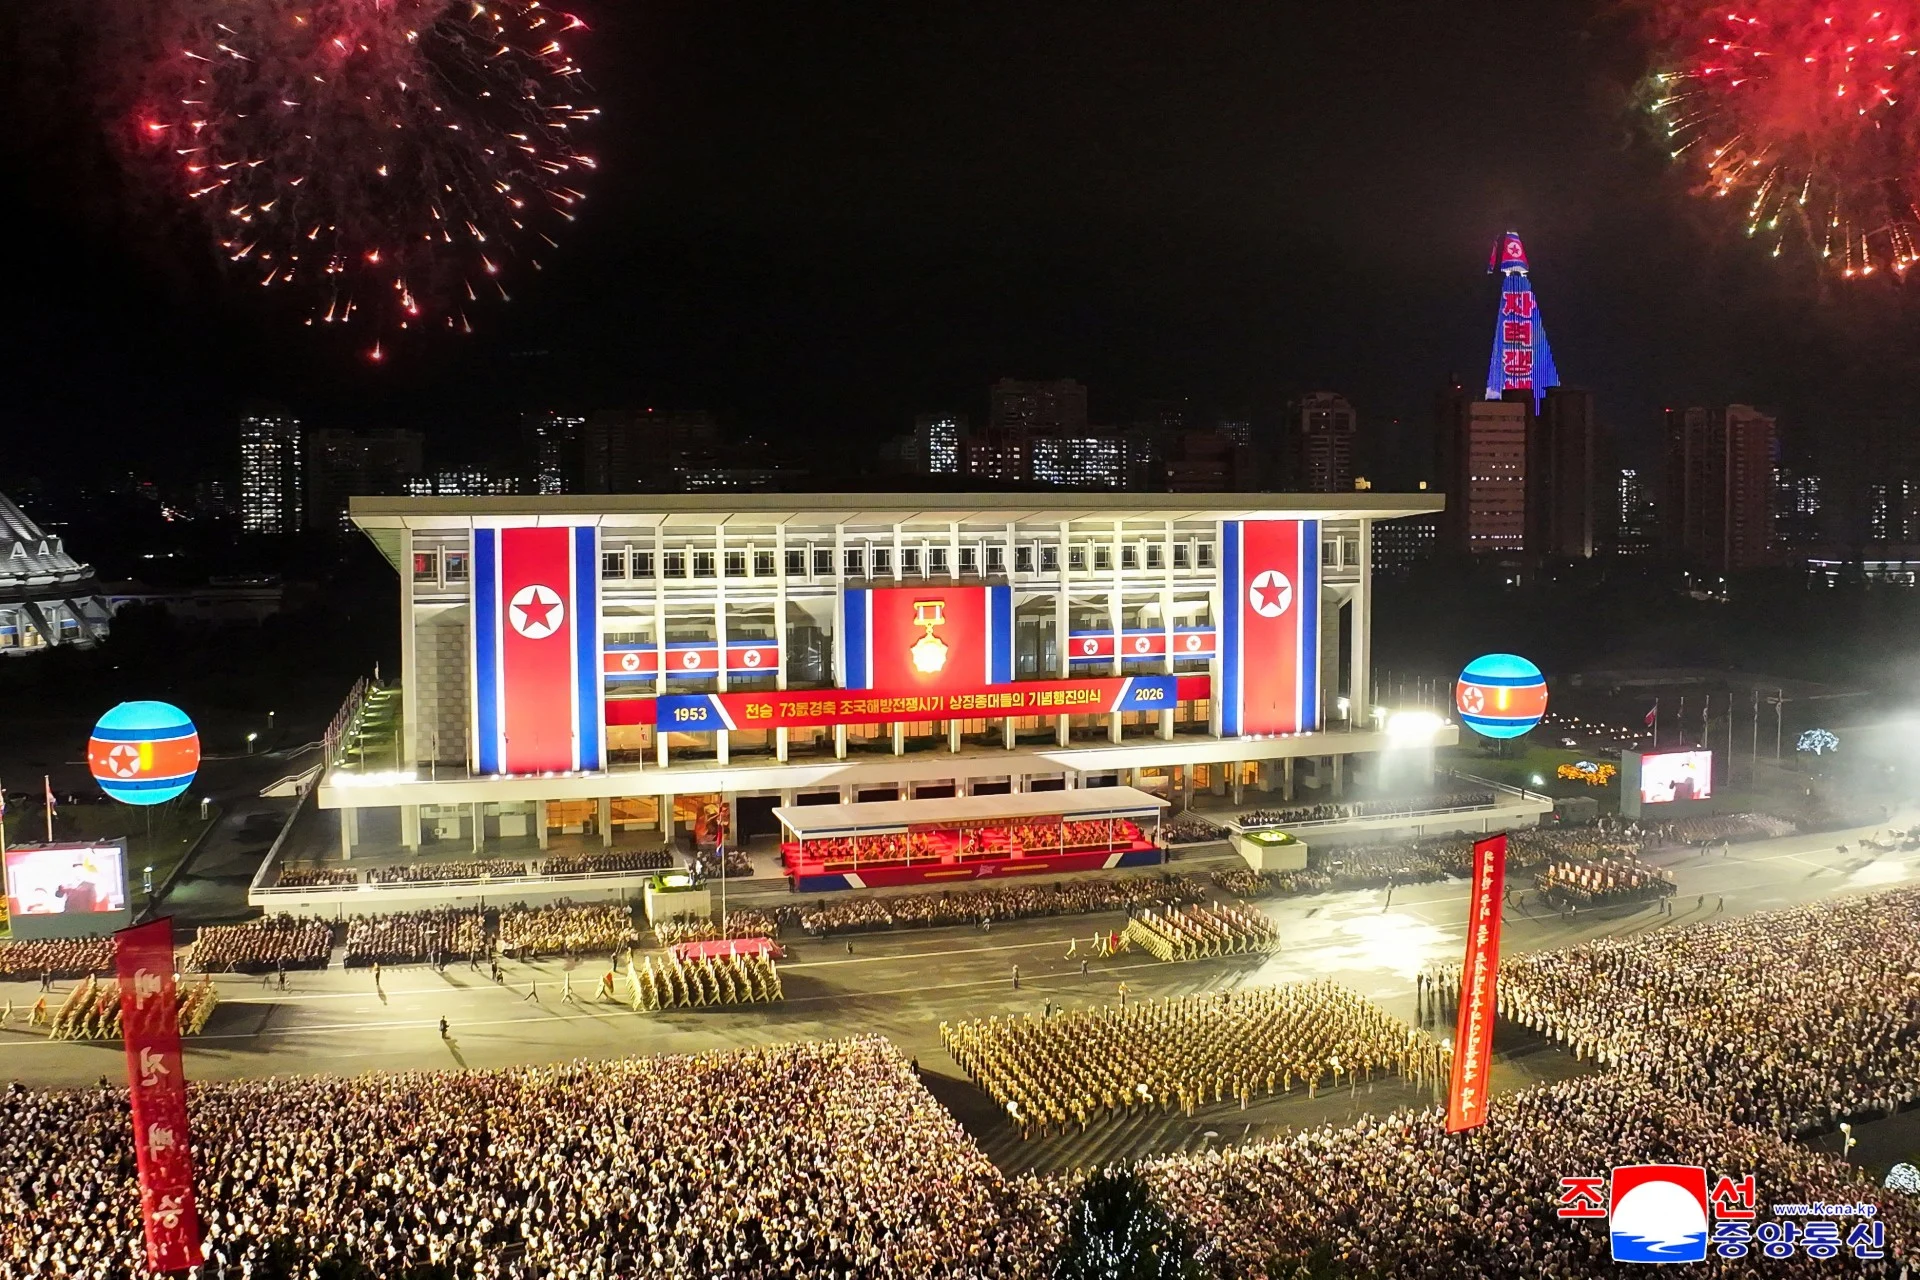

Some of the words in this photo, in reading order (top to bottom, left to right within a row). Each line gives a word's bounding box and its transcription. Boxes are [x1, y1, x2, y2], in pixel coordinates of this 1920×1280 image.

[1135, 688, 1164, 701] 2026
[745, 703, 773, 719] 전승
[840, 696, 944, 715] 조국해방전쟁시기
[950, 692, 1024, 711] 상징종대들의
[1029, 689, 1101, 707] 기념행진의식
[673, 707, 707, 722] 1953
